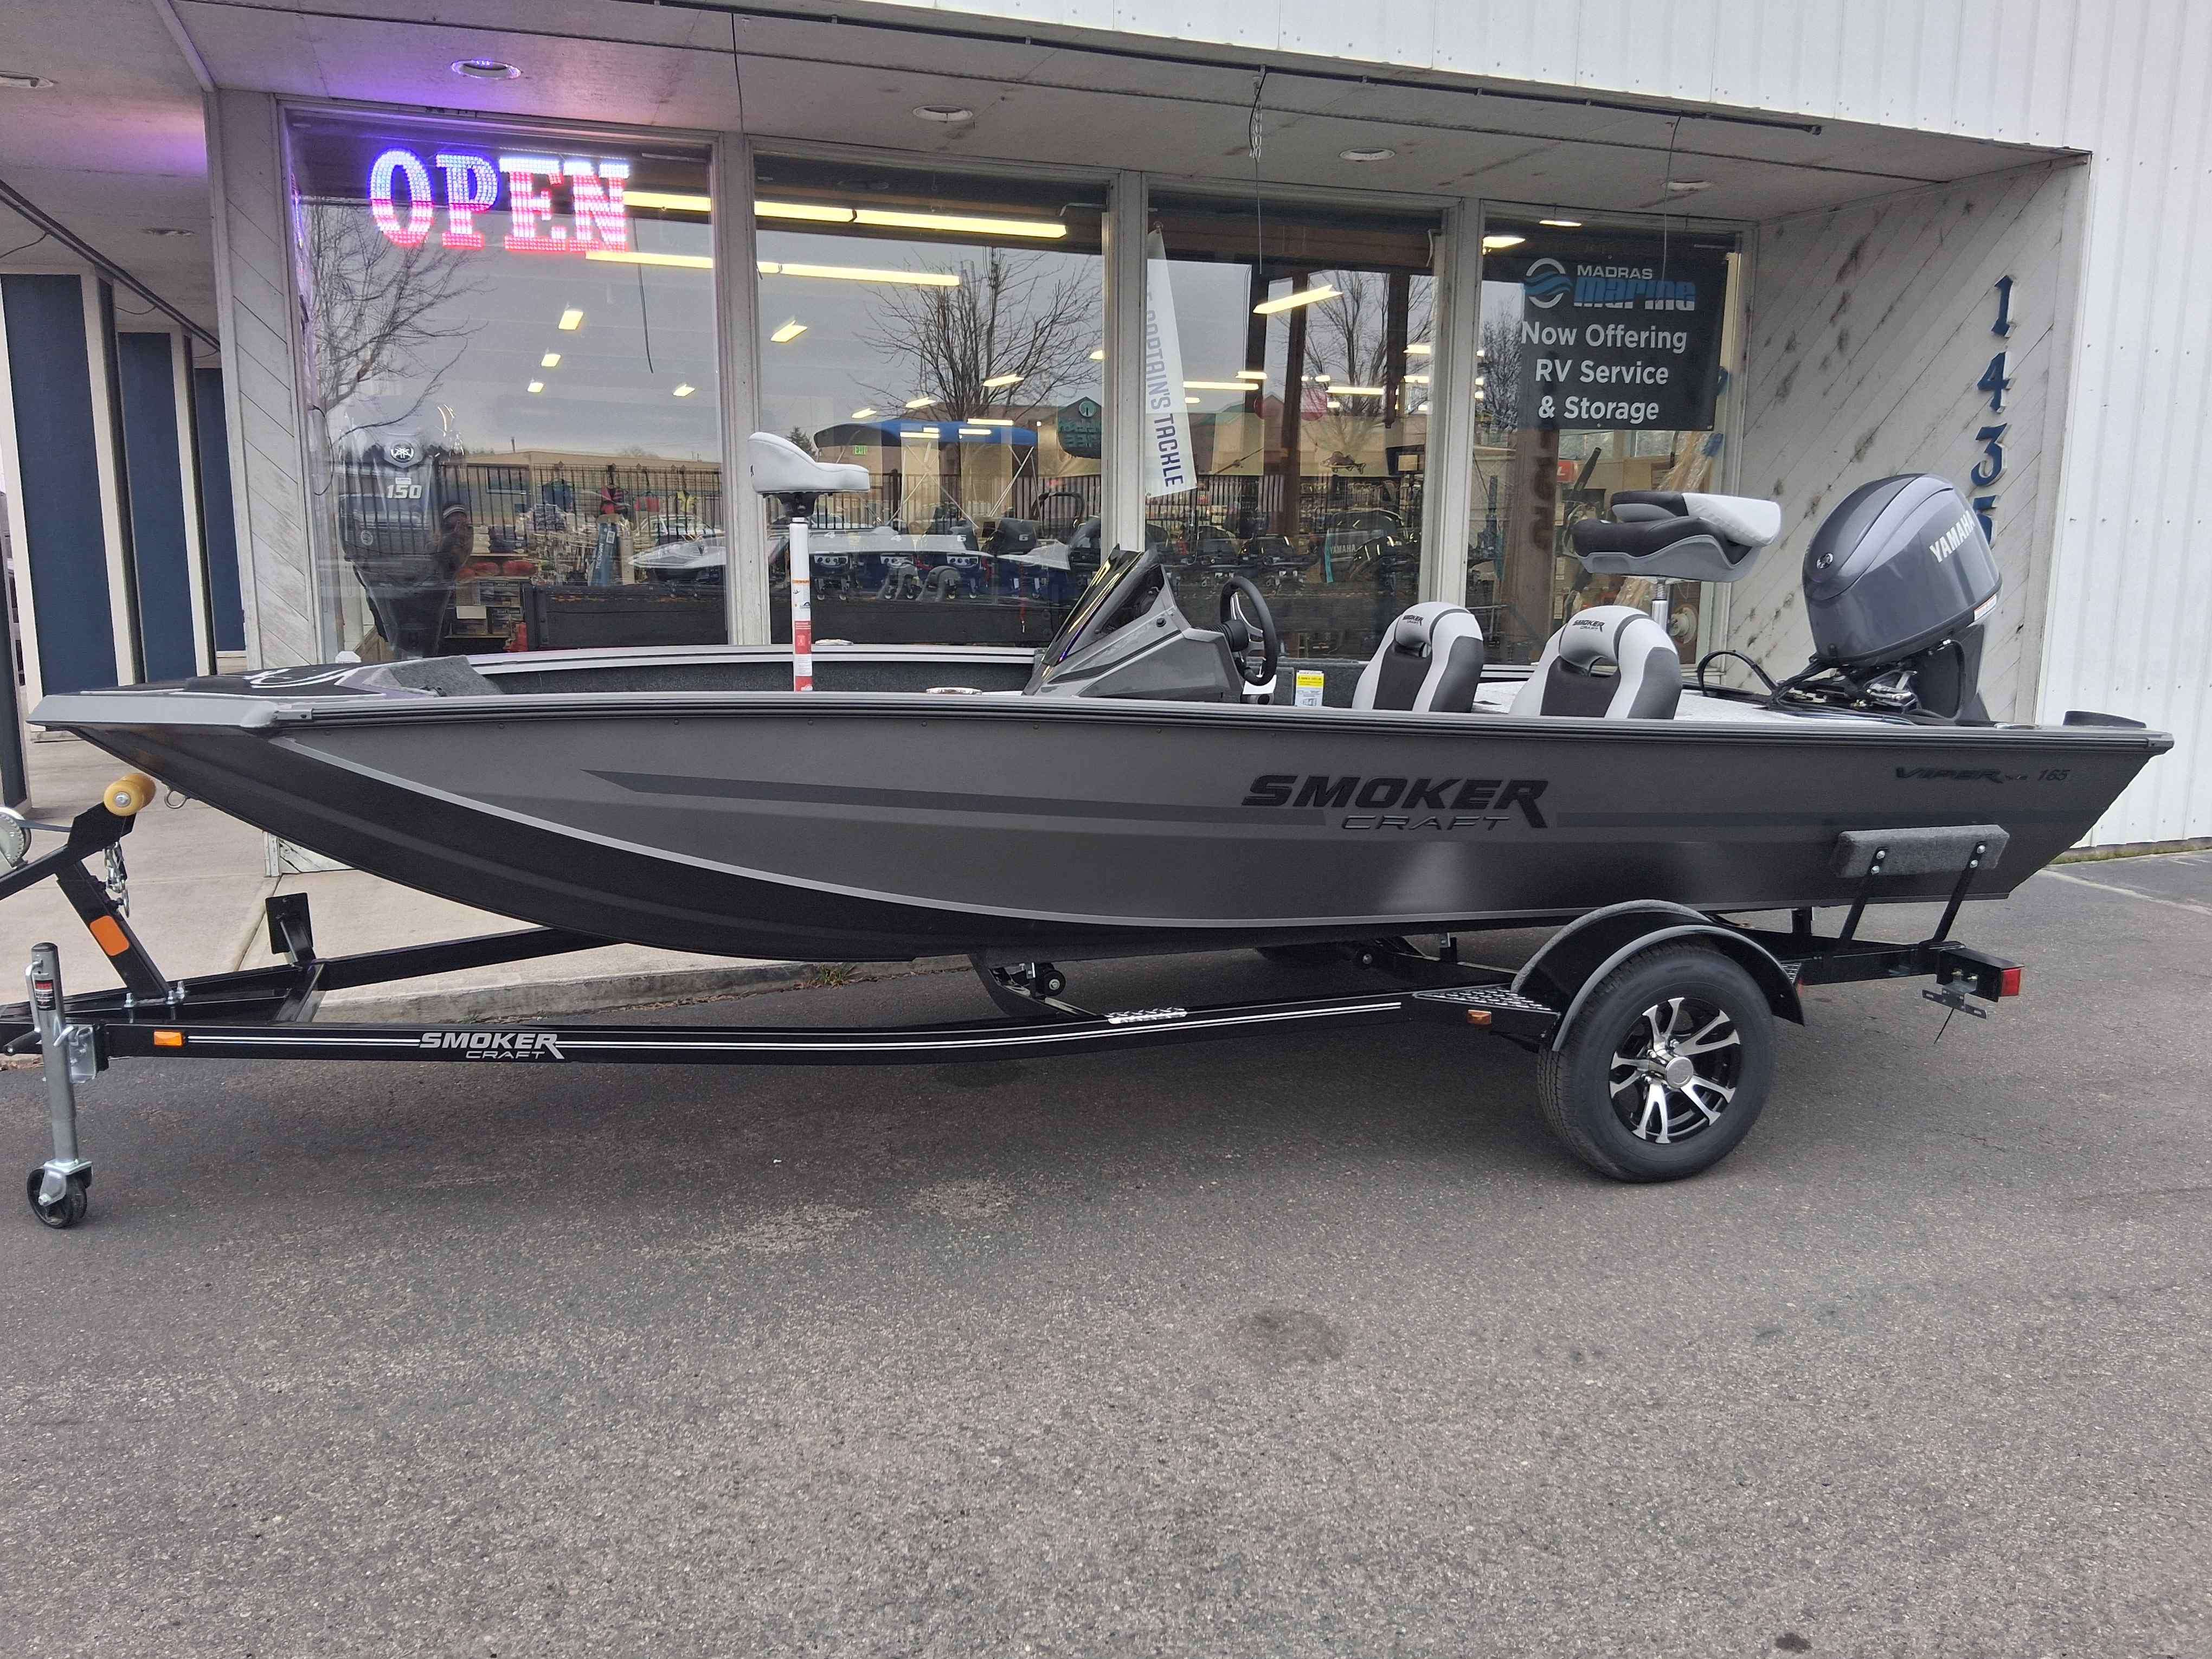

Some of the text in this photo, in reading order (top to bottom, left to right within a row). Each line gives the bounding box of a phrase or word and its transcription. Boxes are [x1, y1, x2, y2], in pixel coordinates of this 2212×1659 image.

[370, 147, 629, 252] OPEN
[1577, 264, 1653, 280] MADRAS
[1573, 276, 1696, 311] marine
[1521, 320, 1687, 354] Now Offering
[1535, 359, 1669, 385] RV Service
[1538, 395, 1659, 424] & Storage
[1154, 413, 1184, 488] TACKLE
[387, 485, 422, 499] 150
[1330, 544, 1356, 555] YAMAHA
[1929, 510, 1975, 564] YAMAHA
[1572, 620, 1605, 633] SMOKER
[1896, 767, 2004, 784] VIPER
[1242, 775, 1549, 828] SMOKER
[1342, 815, 1510, 831] CRAFT
[420, 1032, 565, 1059] SMOKER
[465, 1051, 545, 1059] CRAFT
